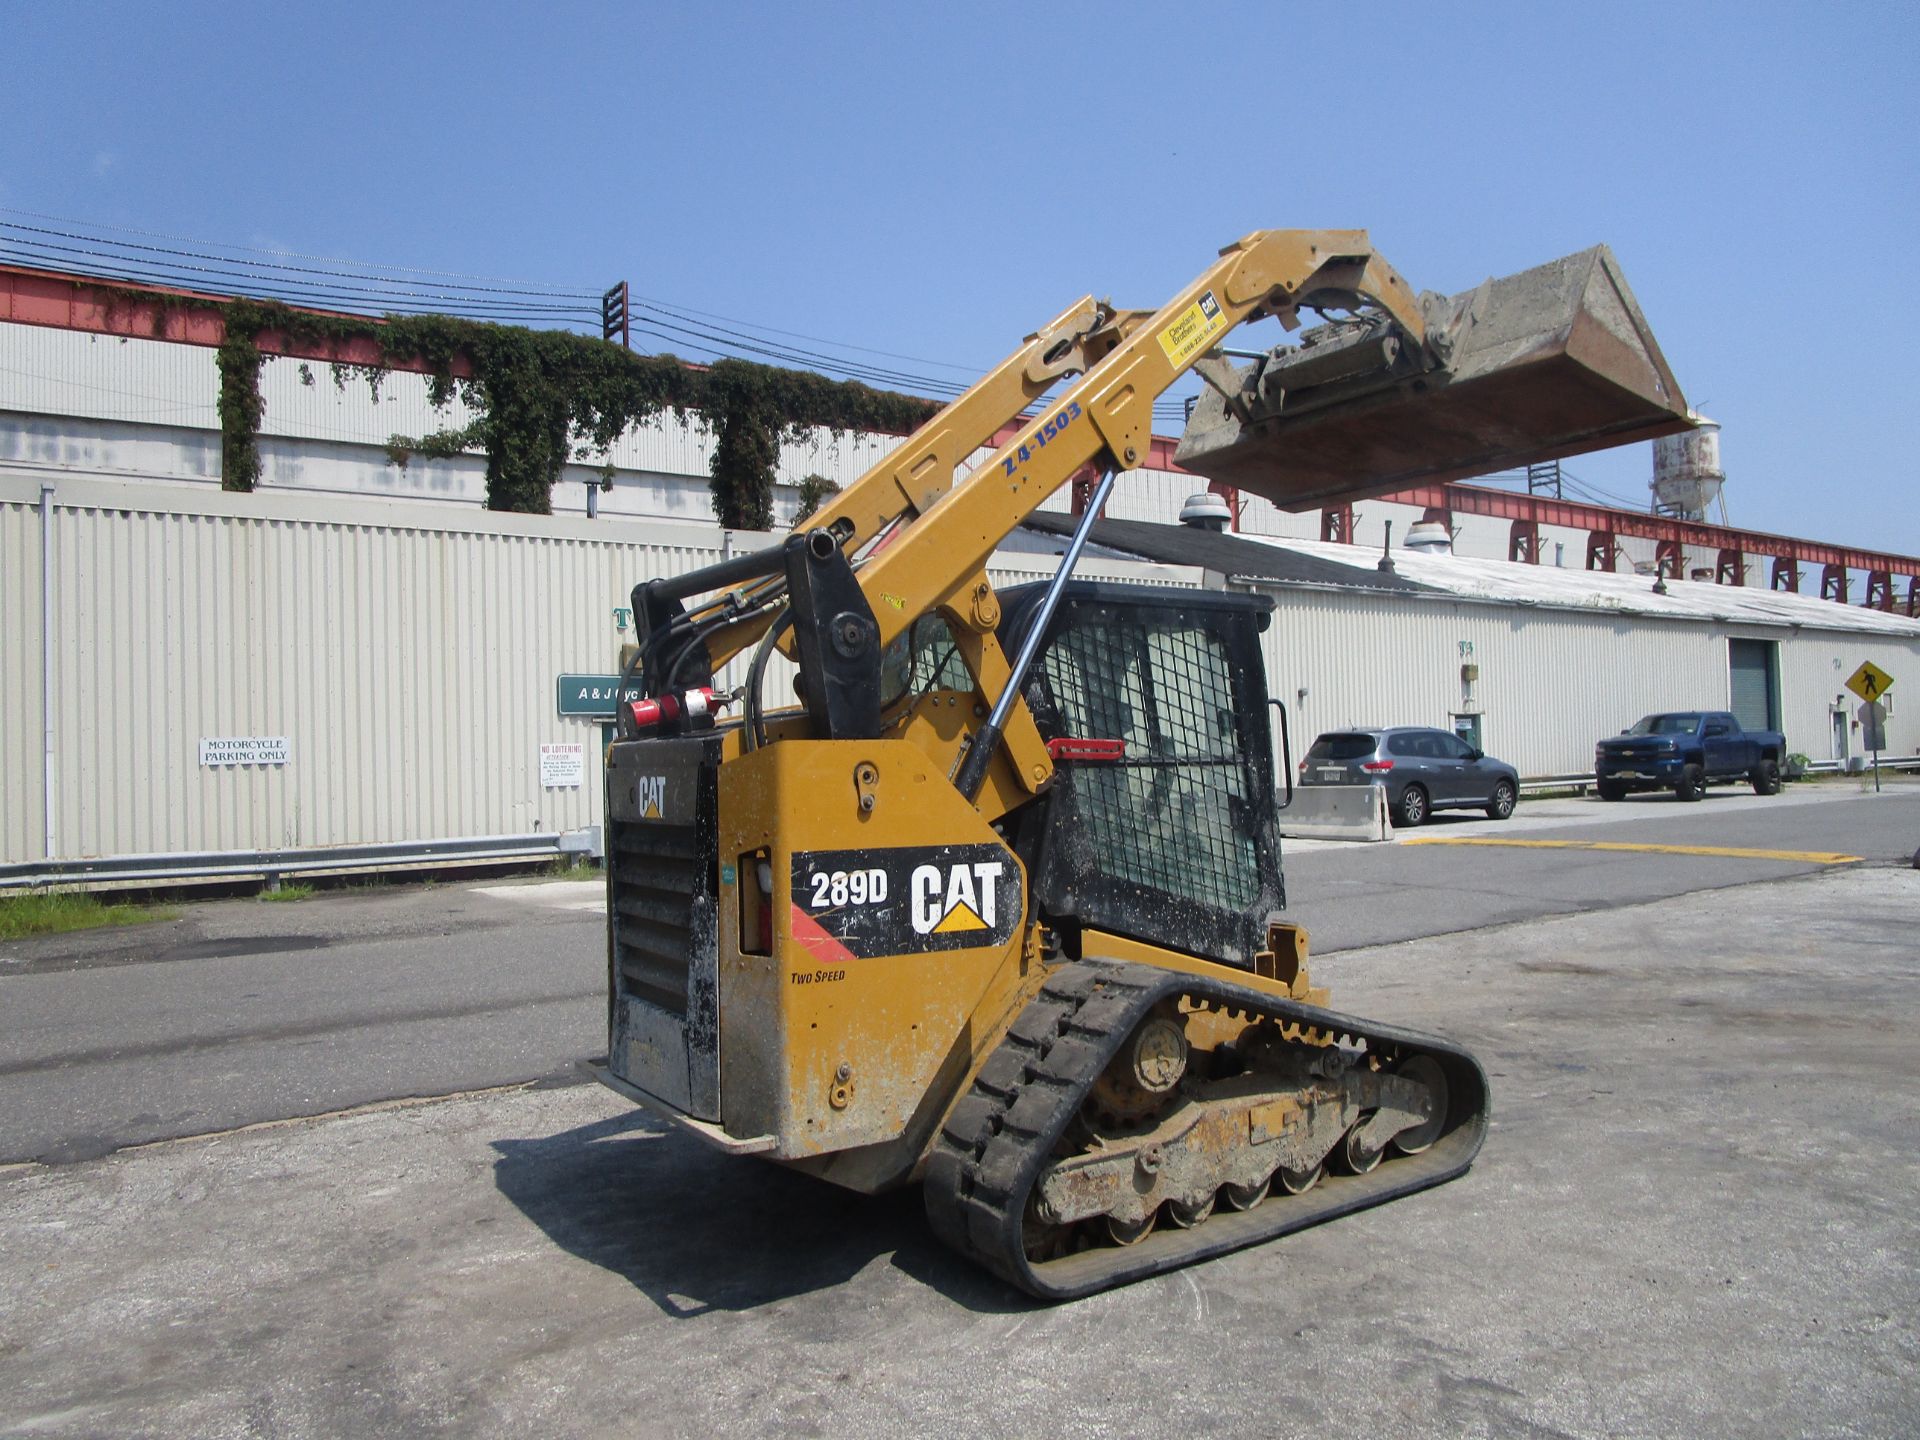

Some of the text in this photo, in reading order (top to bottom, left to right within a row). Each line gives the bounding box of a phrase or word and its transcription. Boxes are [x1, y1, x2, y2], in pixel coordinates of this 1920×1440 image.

[1201, 296, 1216, 314] CAT
[1168, 311, 1196, 337] Cleveland
[1172, 323, 1197, 346] Brothers
[1001, 402, 1082, 478] 24-1503
[613, 607, 636, 629] T
[578, 687, 588, 699] A
[592, 687, 600, 700] &
[604, 687, 611, 700] J
[205, 751, 286, 761] PARKING ONLY
[208, 740, 283, 750] MOTORCYCLE
[541, 745, 582, 753] NO LOITERING
[639, 775, 666, 818] CAT
[811, 861, 1002, 935] 289D CAT
